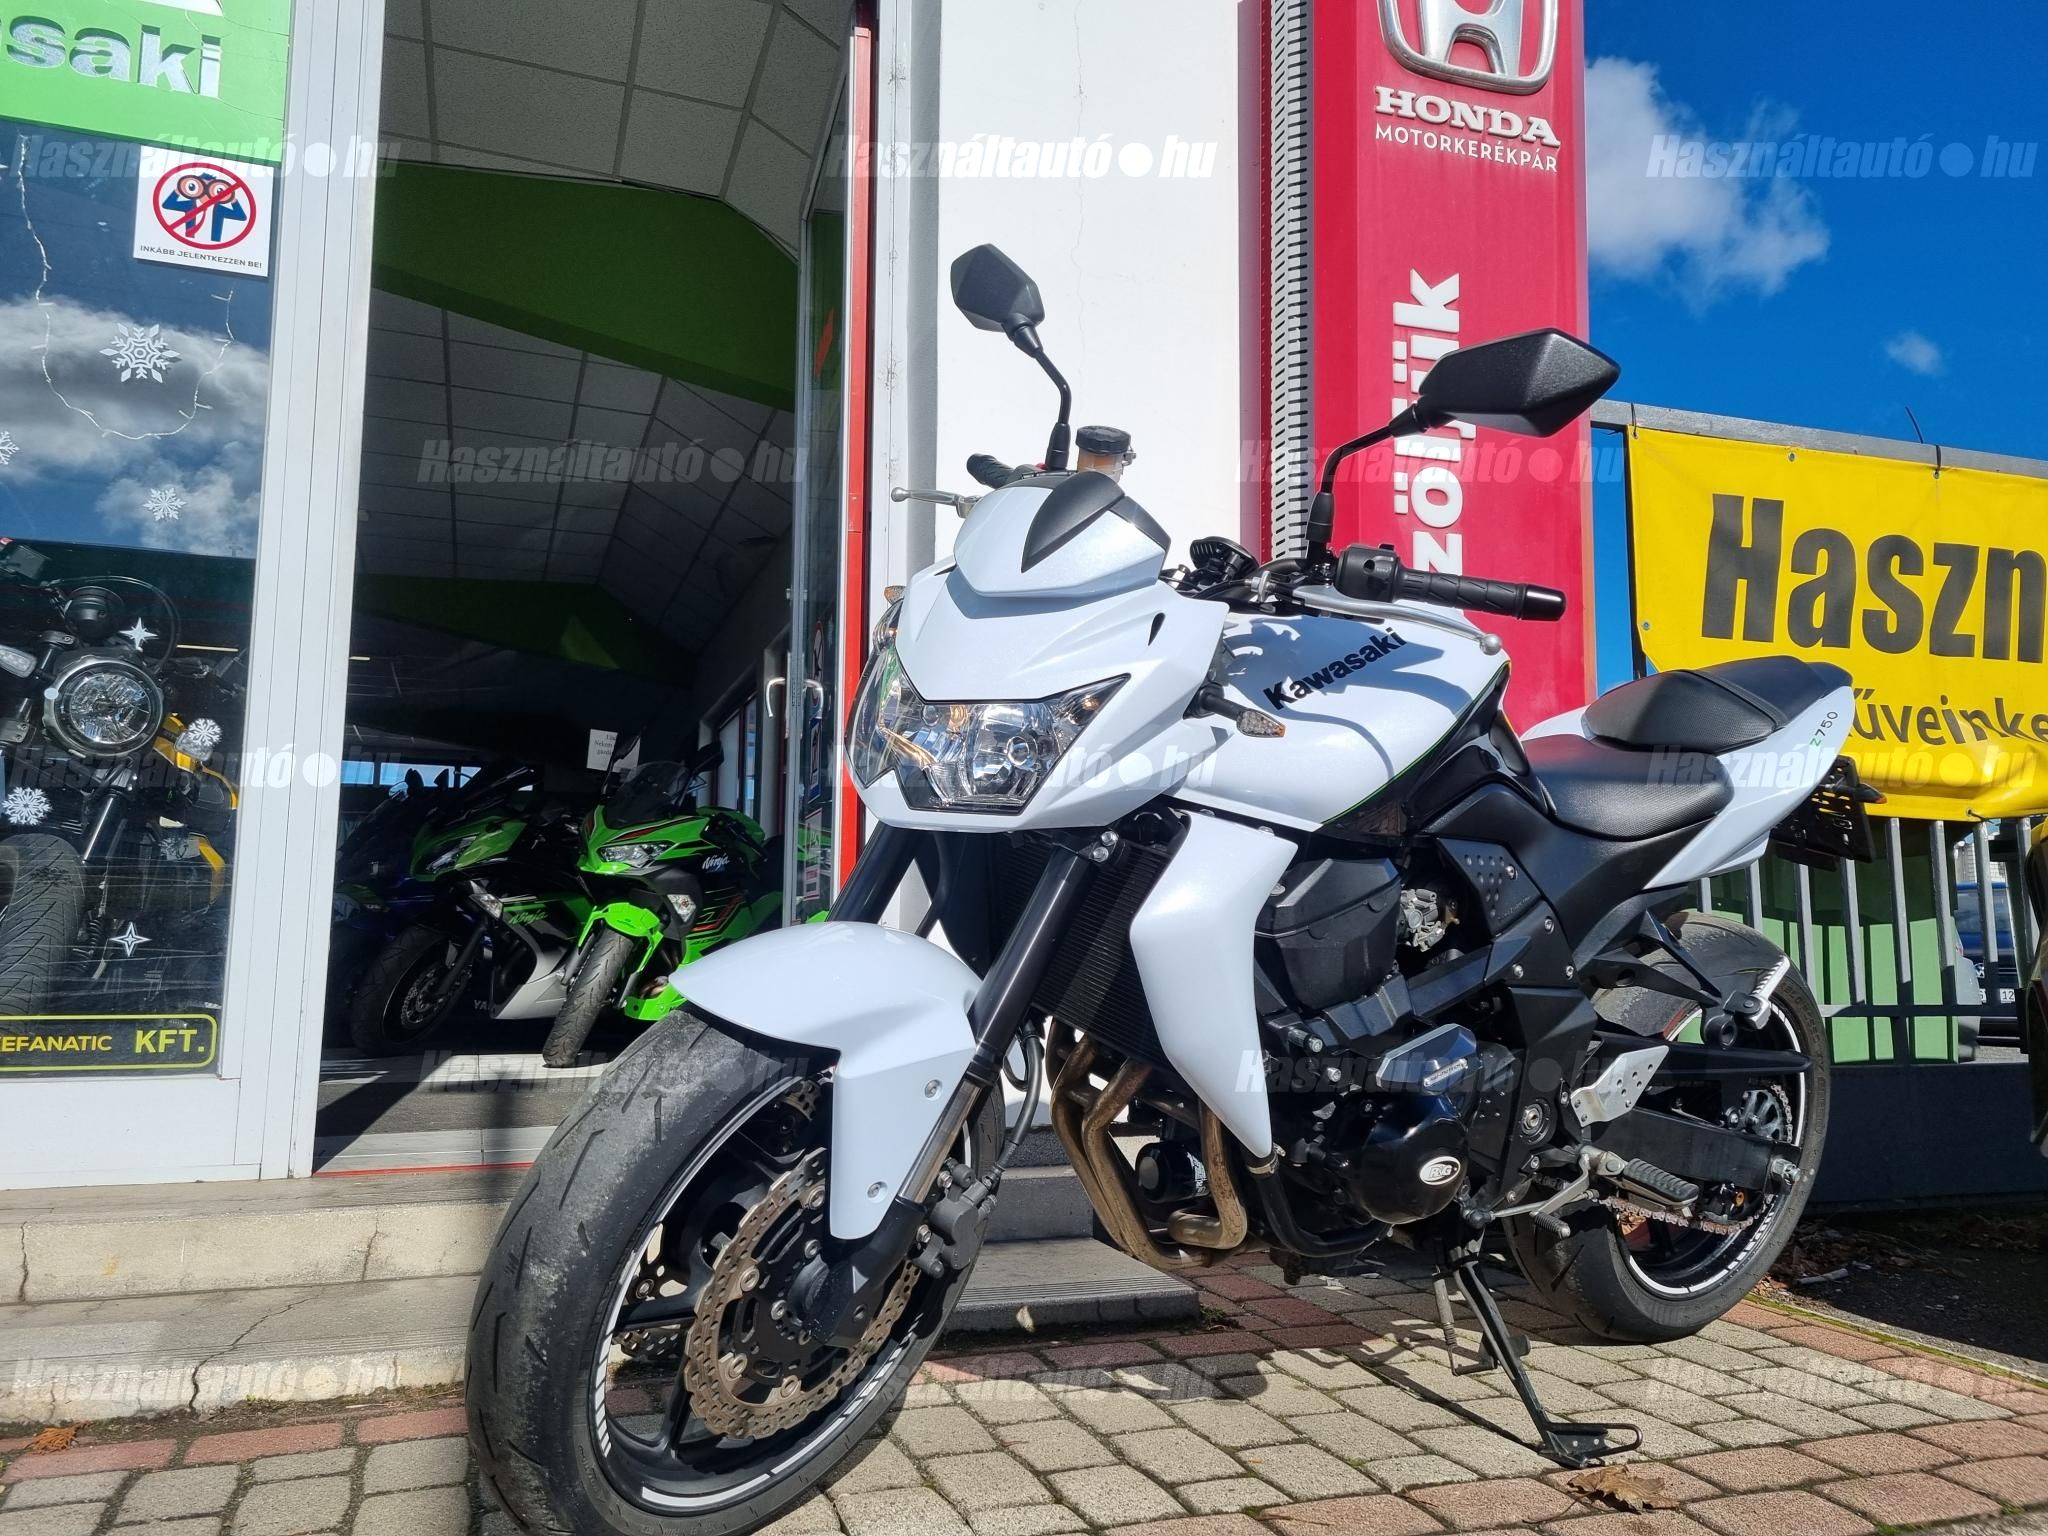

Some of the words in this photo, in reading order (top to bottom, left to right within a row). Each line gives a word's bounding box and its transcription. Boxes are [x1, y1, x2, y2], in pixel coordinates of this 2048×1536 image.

[0, 15, 222, 98] saki
[1375, 86, 1561, 148] HONDA
[1375, 121, 1558, 173] MOTORKERÉKPÁR
[177, 250, 246, 267] JELENTKEZZEN
[1701, 493, 2048, 664] Haszn
[1263, 627, 1408, 711] Kawasaki
[1848, 688, 2048, 745] űveinke
[702, 853, 731, 871] Ninja
[0, 1035, 113, 1052] EFANATIC
[135, 1029, 205, 1054] KFT.
